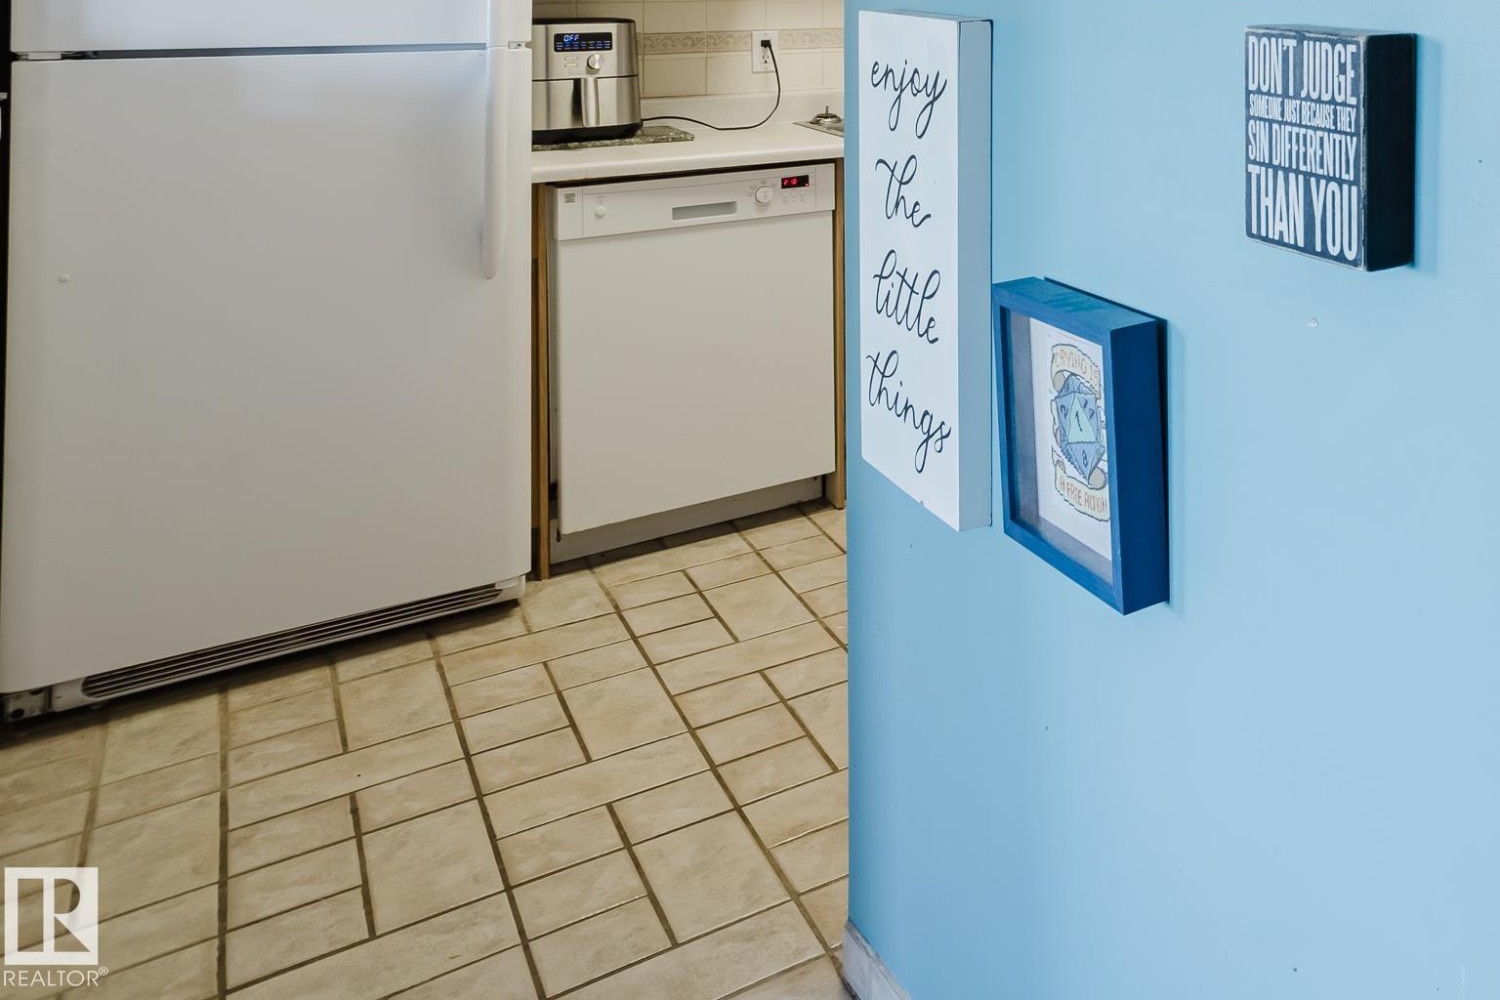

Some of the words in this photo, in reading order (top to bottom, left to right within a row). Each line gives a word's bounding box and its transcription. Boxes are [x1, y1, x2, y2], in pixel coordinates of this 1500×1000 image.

[563, 34, 580, 42] OFF
[1248, 34, 1297, 97] DON'T
[1300, 39, 1358, 105] JUDGE
[870, 58, 948, 139] enjoy
[1249, 93, 1283, 121] SOMEONE
[1283, 98, 1301, 124] JUST
[1301, 100, 1336, 130] BECAUSE
[1336, 105, 1357, 133] THEY
[1248, 119, 1270, 164] SIN
[1271, 122, 1358, 181] DIFFERENTLY
[1248, 163, 1305, 248] THAN
[1310, 176, 1358, 261] YOU
[873, 249, 941, 344] little
[866, 350, 951, 474] things
